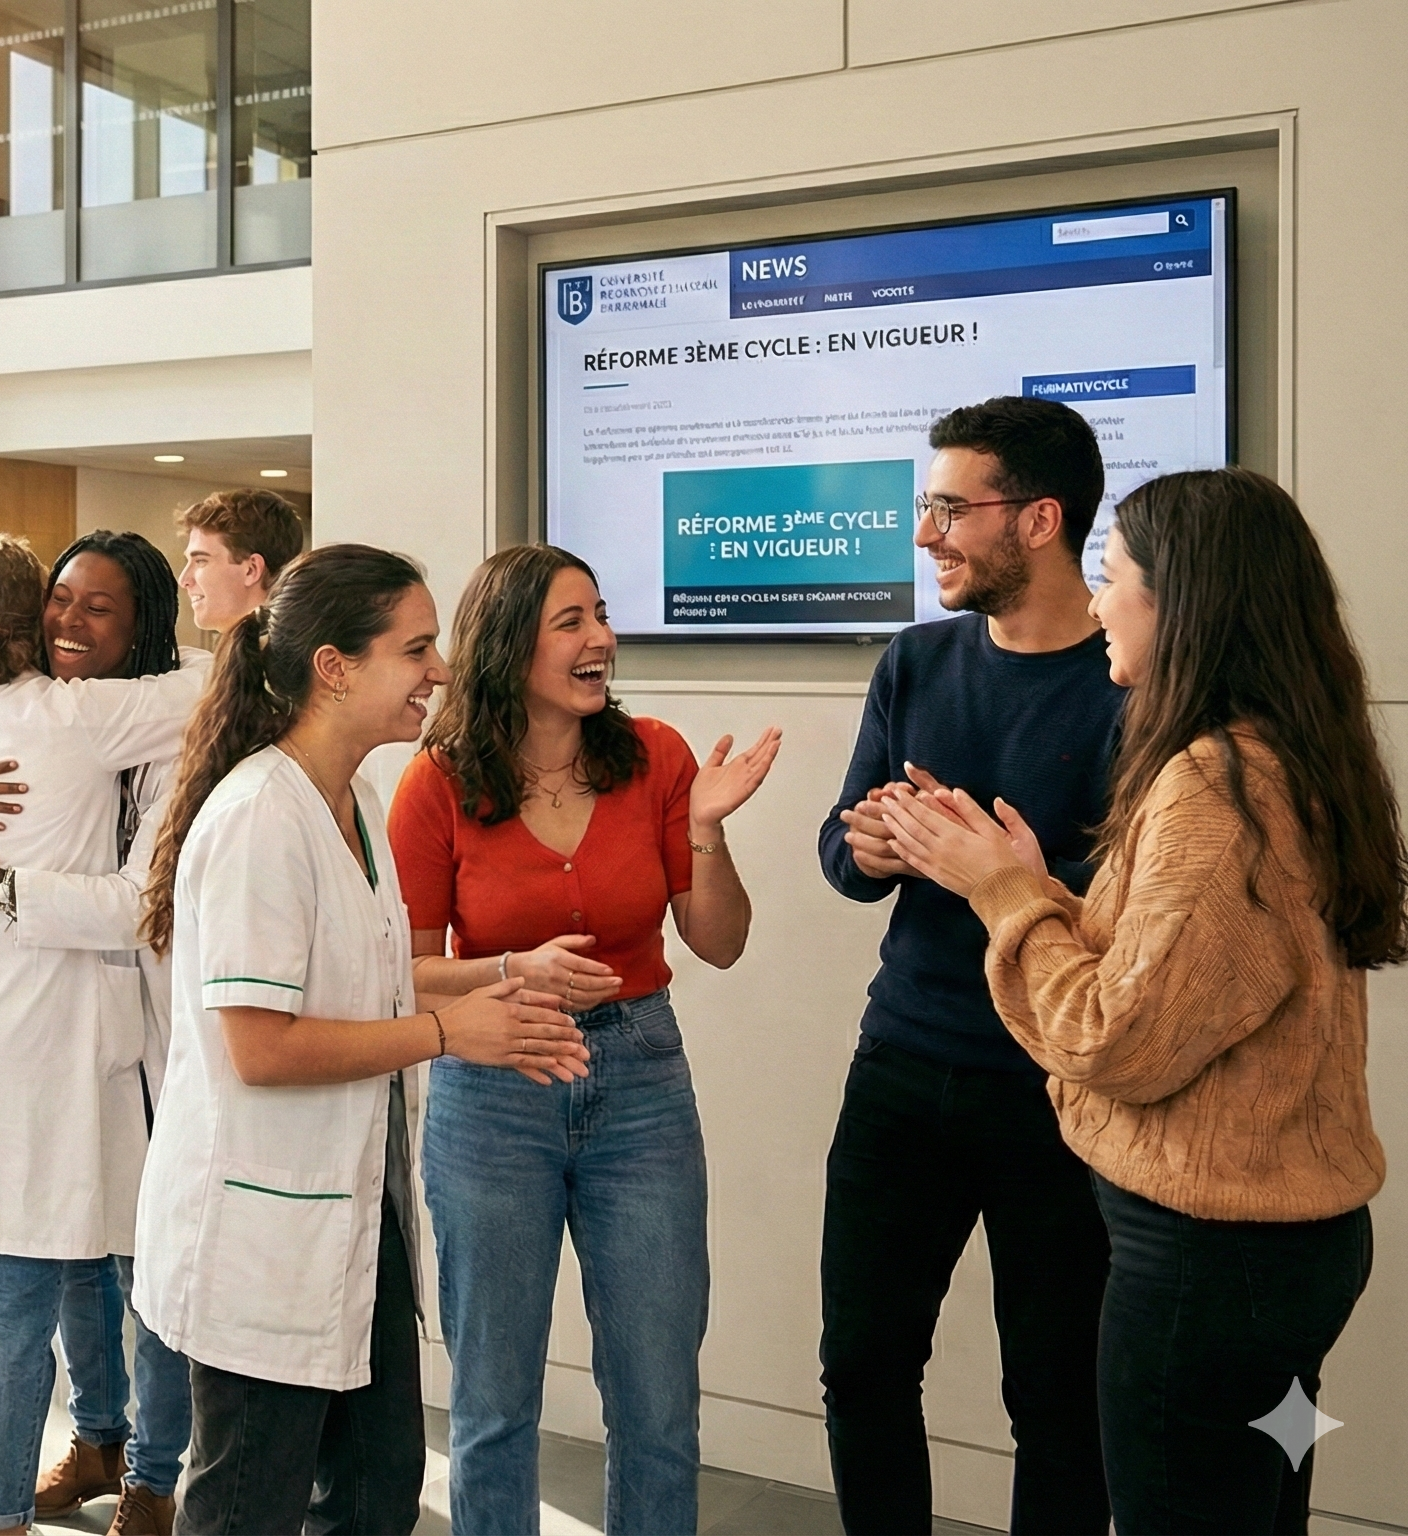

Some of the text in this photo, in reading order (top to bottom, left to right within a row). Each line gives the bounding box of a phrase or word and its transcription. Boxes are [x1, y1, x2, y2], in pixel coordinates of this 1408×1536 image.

[742, 255, 808, 281] NEWS
[584, 347, 678, 371] RÉFORME
[684, 340, 739, 363] 3ÈME
[744, 336, 810, 359] CYCLE
[828, 332, 856, 352] EN
[862, 323, 965, 349] VIGUEUR
[972, 322, 978, 341] !
[677, 510, 899, 536] RÉFORME 3ÈME CYCLE
[721, 541, 749, 559] EN
[753, 538, 849, 558] VIGUEUR
[854, 537, 861, 555] !
